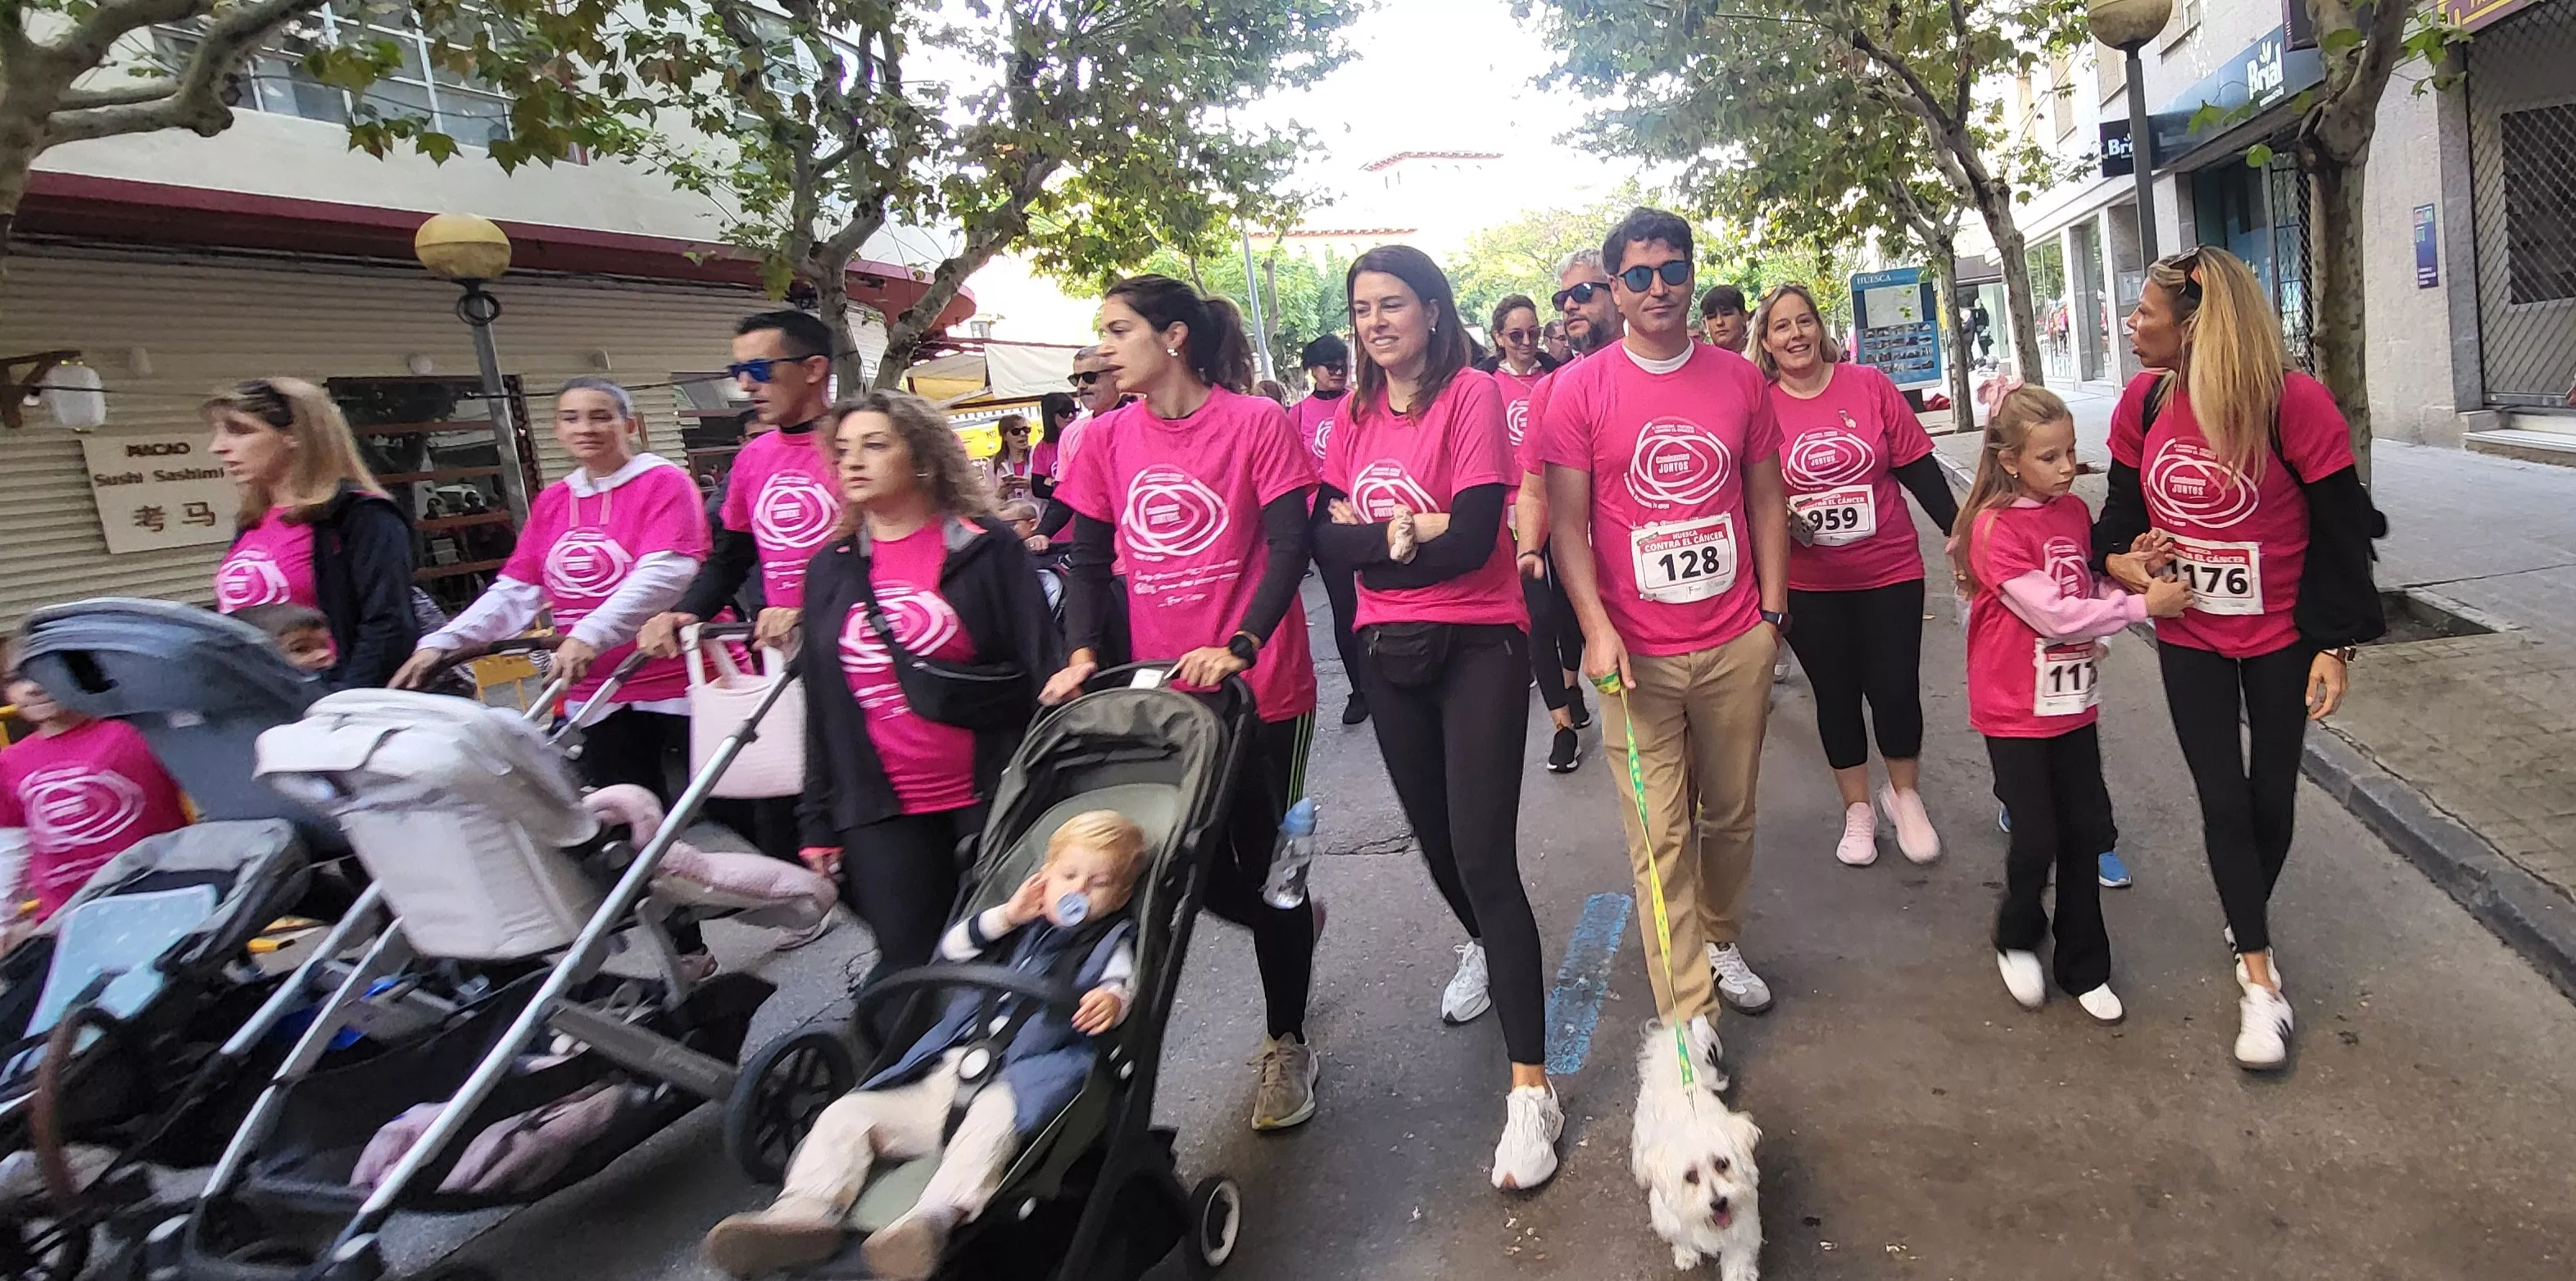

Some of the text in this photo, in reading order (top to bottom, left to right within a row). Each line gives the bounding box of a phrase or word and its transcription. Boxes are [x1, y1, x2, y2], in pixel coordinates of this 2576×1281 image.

[2247, 41, 2284, 100] Brial
[2108, 139, 2133, 156] Bri
[1857, 274, 1891, 284] HUESCA
[125, 443, 191, 457] MACAO
[1658, 461, 1689, 474] JUNTOS
[94, 467, 224, 486] Sushi Sashimi
[2172, 484, 2203, 496] JUNTOS
[1807, 507, 1858, 531] 959
[1644, 540, 1680, 552] CONTRA
[1694, 531, 1724, 543] CÁNCER
[1672, 530, 1698, 539] HUESCA
[1658, 546, 1720, 581] 128
[2206, 555, 2245, 563] CÁNCER
[2166, 559, 2247, 594] 1176
